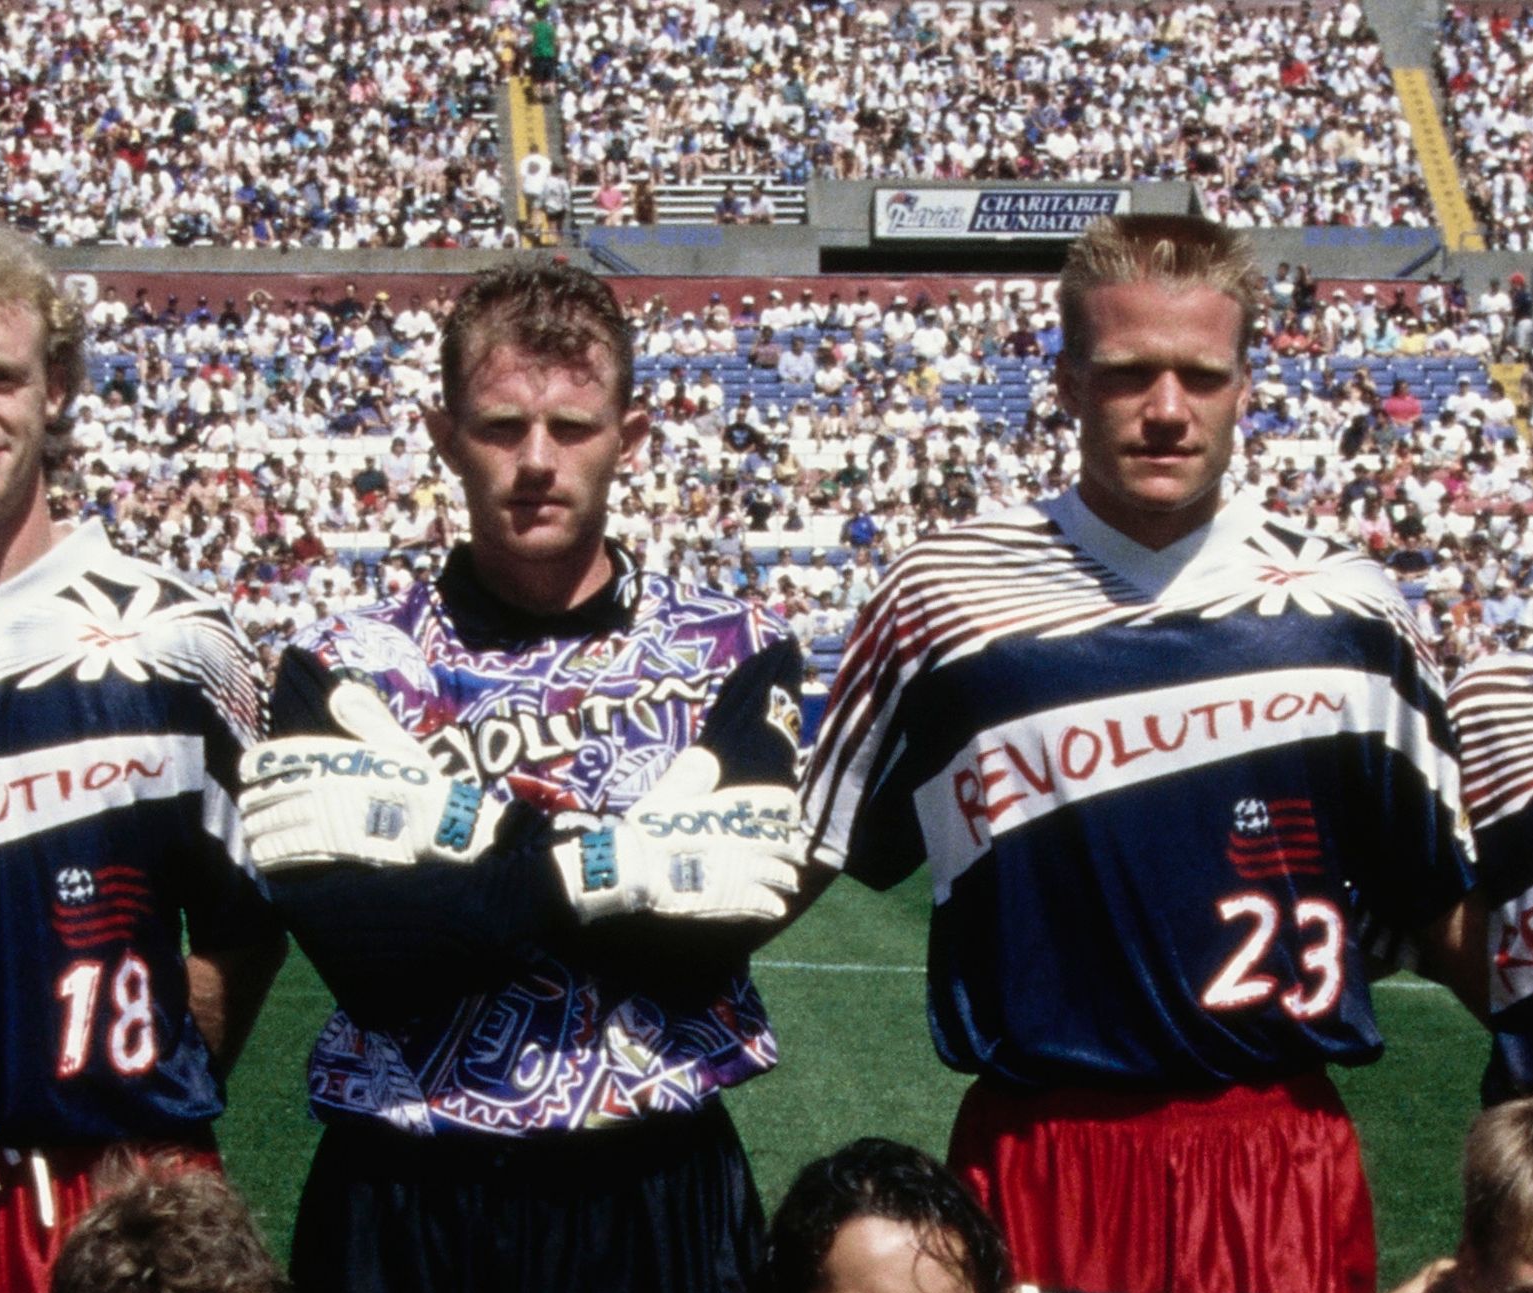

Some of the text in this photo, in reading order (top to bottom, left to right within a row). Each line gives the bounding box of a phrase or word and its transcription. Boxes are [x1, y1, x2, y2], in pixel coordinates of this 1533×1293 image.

[974, 214, 1095, 230] FOUNDATIO
[980, 197, 1111, 213] CHARITABLE
[953, 692, 1347, 847] REVOLUTION
[53, 948, 160, 1080] 18
[1199, 890, 1346, 1021] 23
